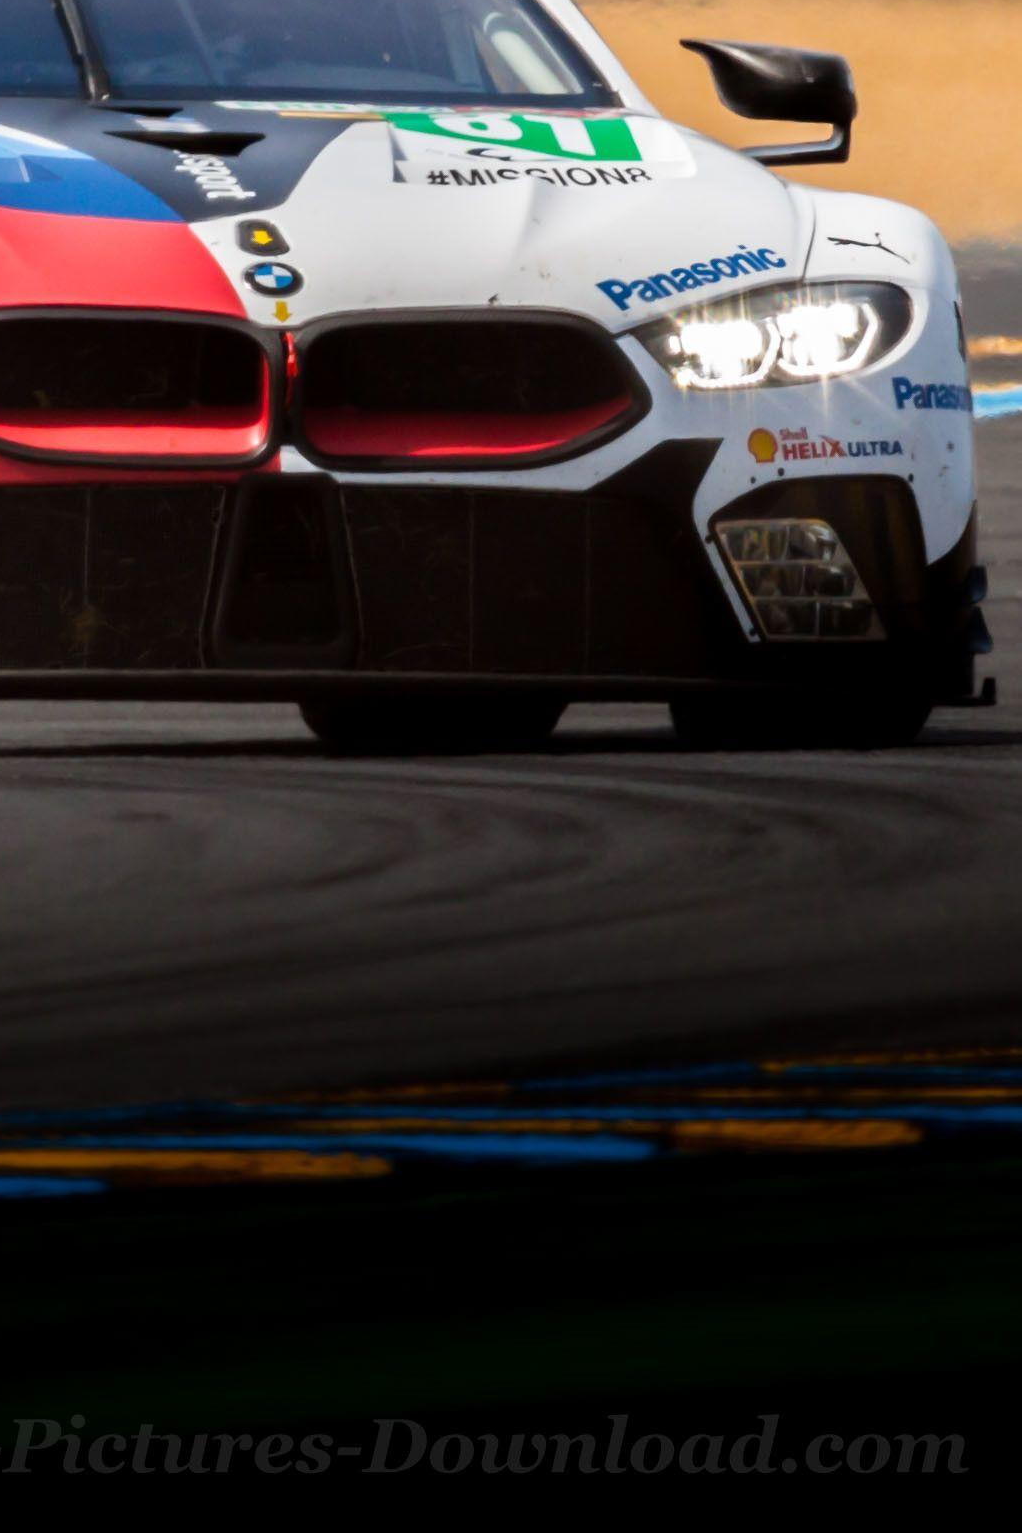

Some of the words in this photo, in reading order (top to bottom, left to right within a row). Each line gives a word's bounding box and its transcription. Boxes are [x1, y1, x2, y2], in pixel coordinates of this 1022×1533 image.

[595, 245, 786, 312] Panasonic
[779, 428, 808, 441] Shell
[782, 434, 847, 459] HELIX
[848, 439, 904, 457] ULTRA
